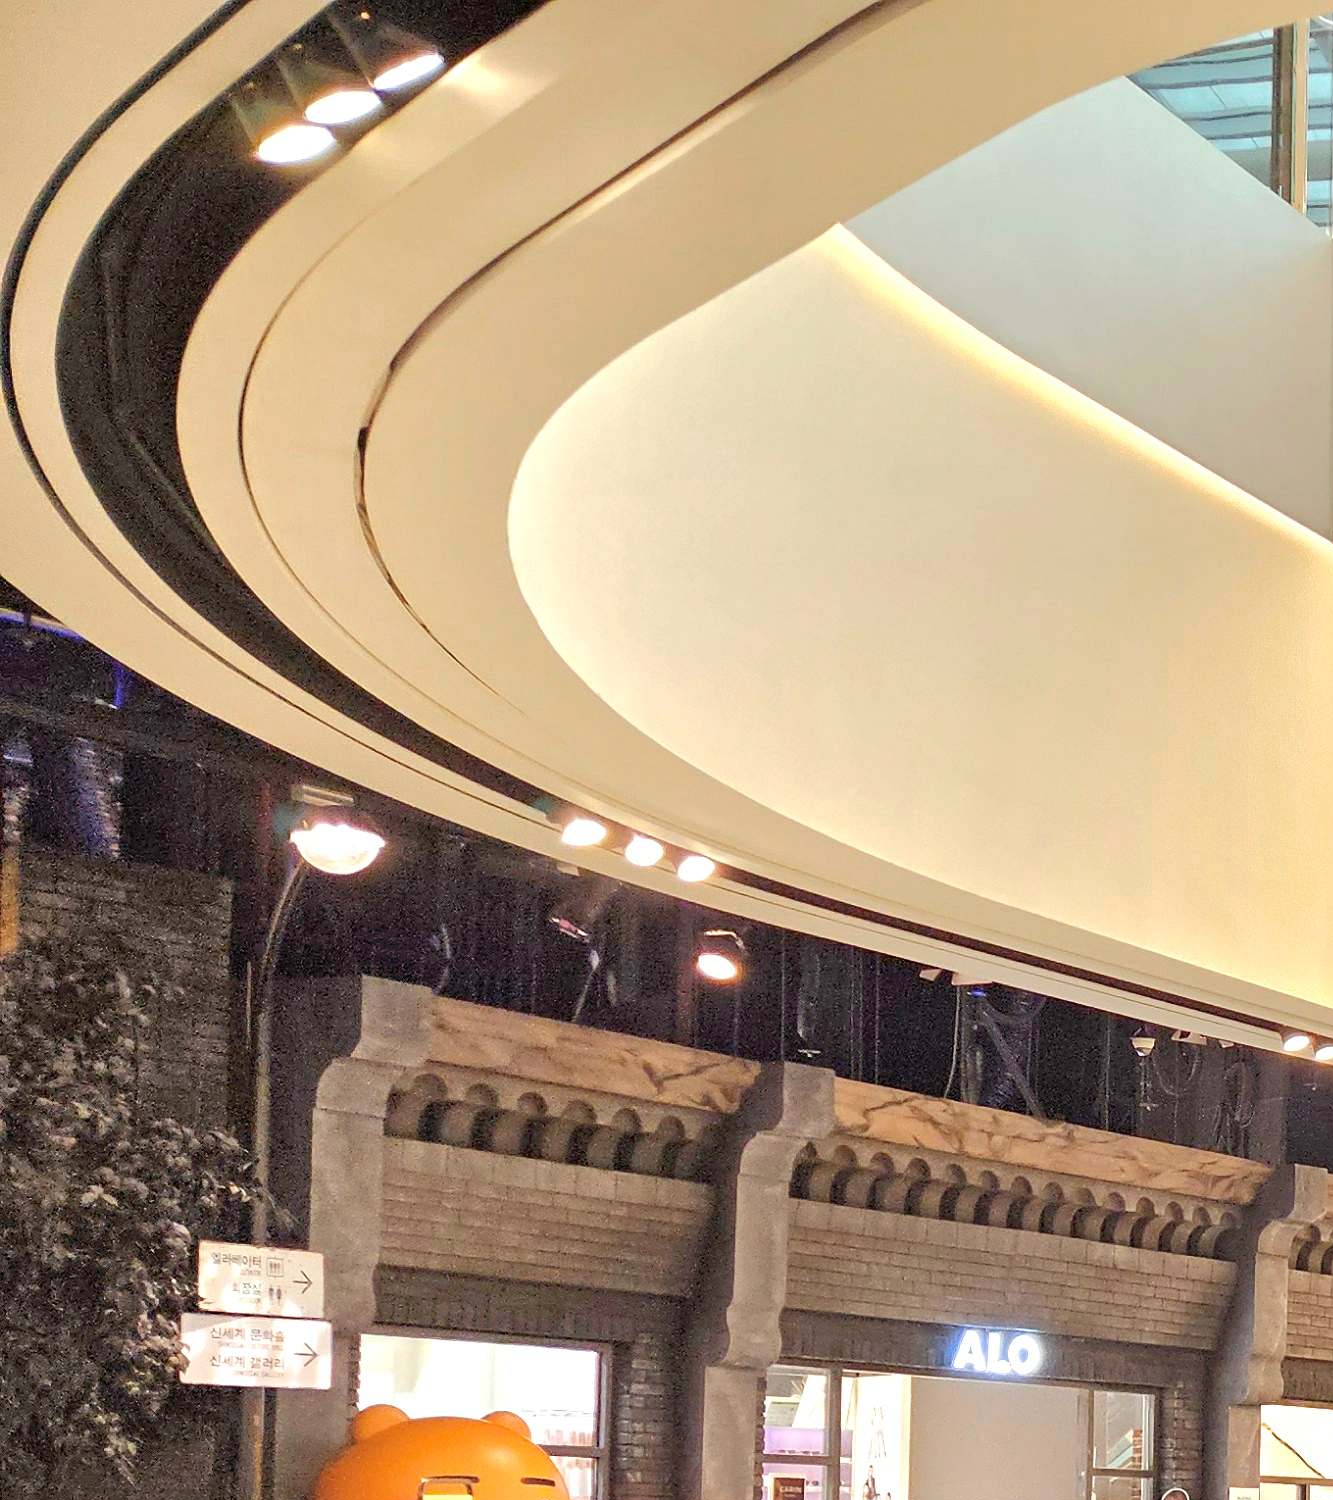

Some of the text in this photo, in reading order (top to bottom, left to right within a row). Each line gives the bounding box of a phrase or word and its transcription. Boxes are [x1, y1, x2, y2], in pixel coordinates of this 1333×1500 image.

[210, 1327, 246, 1341] 신세계
[953, 1329, 1041, 1375] ALO
[209, 1354, 246, 1368] 신세계
